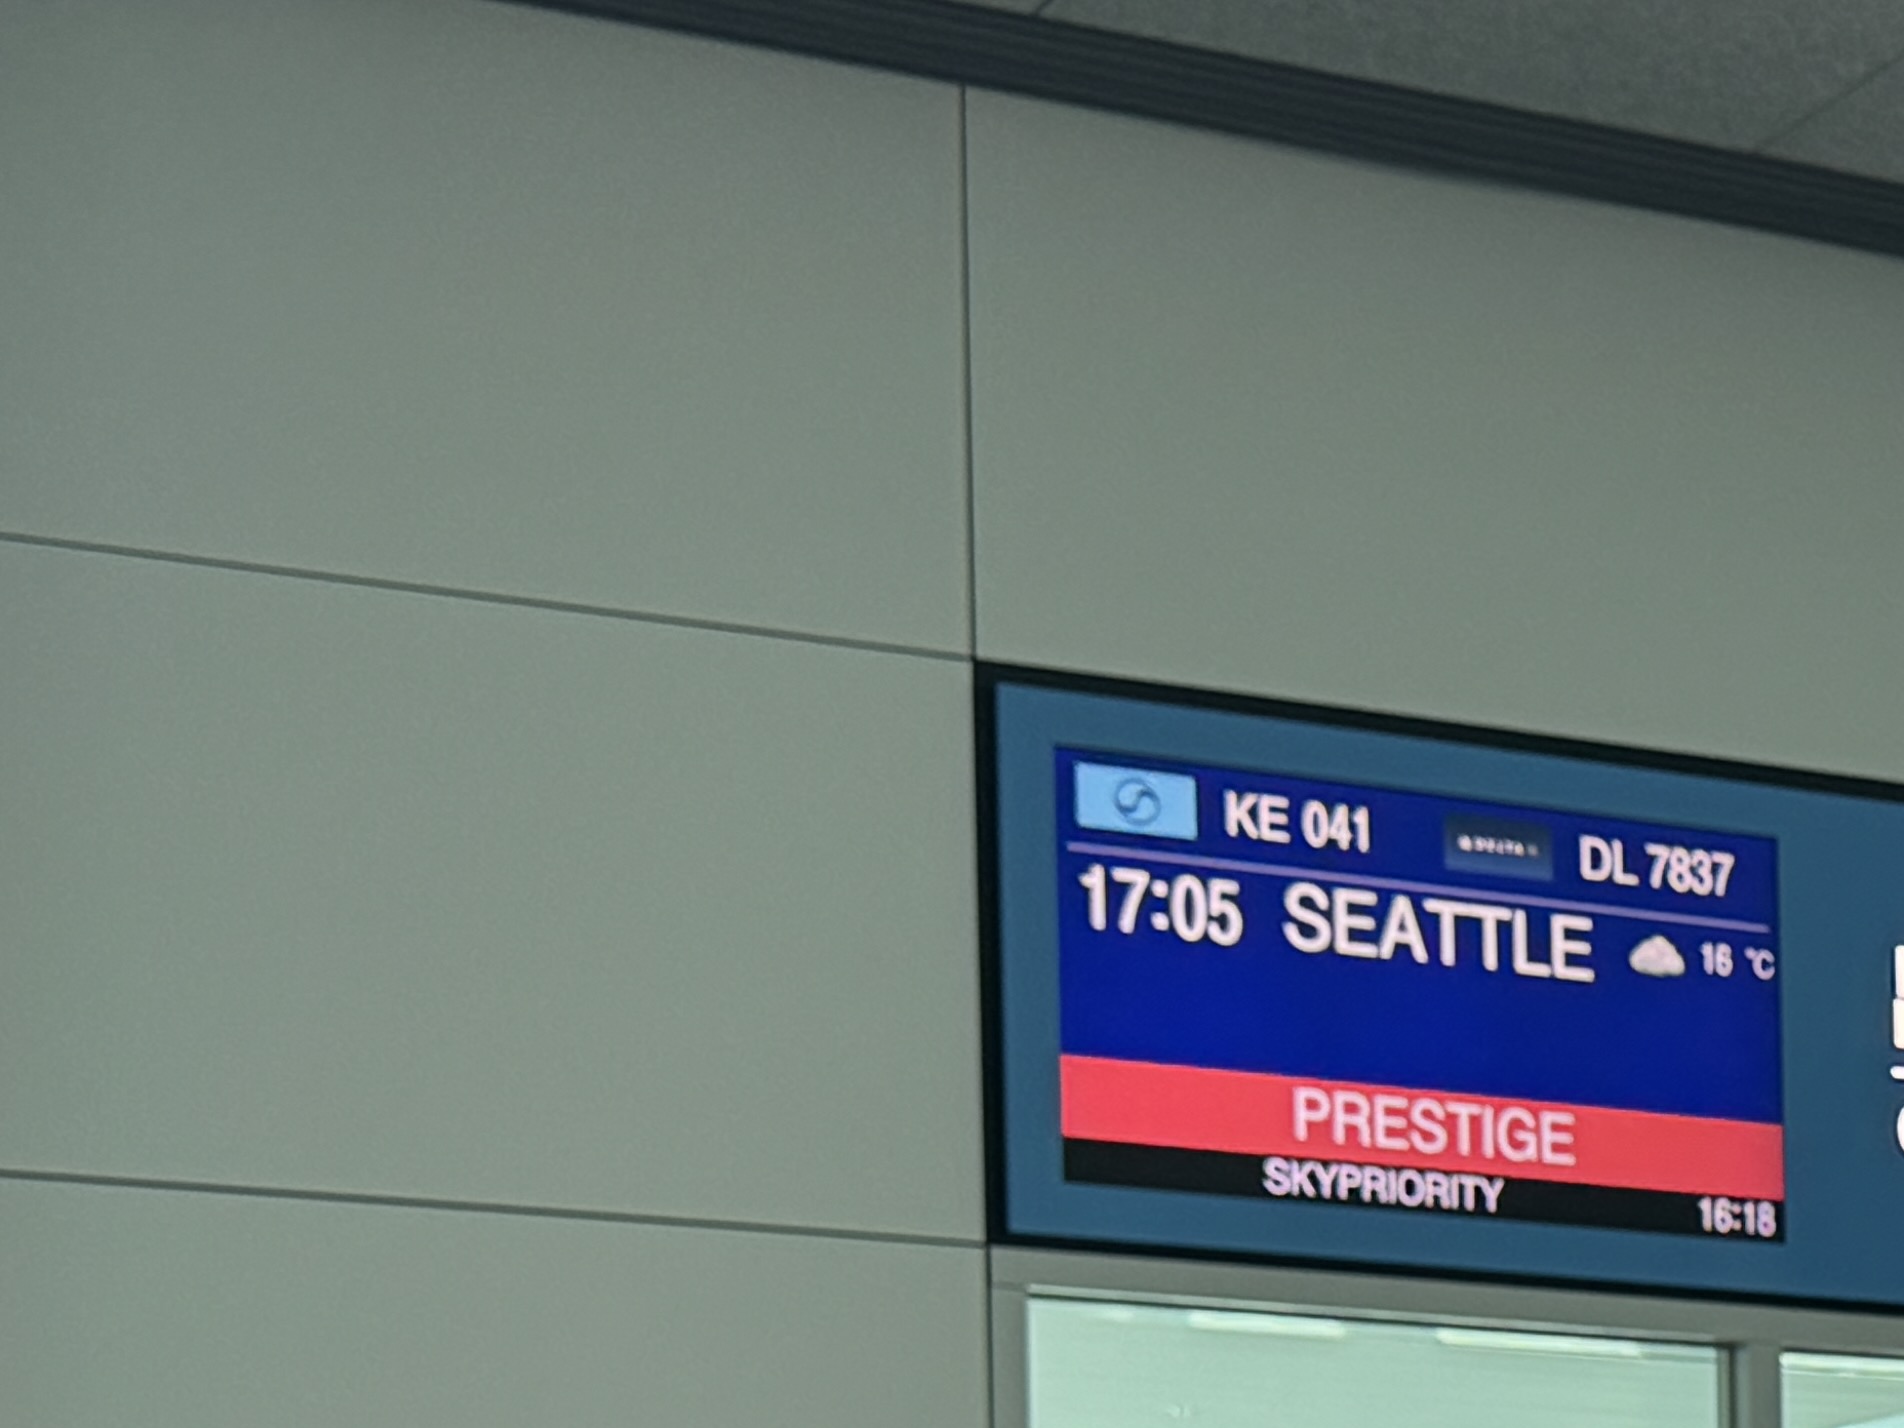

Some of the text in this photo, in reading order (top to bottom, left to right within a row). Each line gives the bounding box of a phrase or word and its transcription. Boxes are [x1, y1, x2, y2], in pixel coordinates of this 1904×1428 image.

[1224, 790, 1370, 853] KE 041
[1578, 834, 1735, 897] DL 7837
[1079, 865, 1595, 983] 17:05 SEATTLE
[1293, 1087, 1577, 1167] PRESTIGE
[1262, 1159, 1505, 1214] SKYPRIORITY
